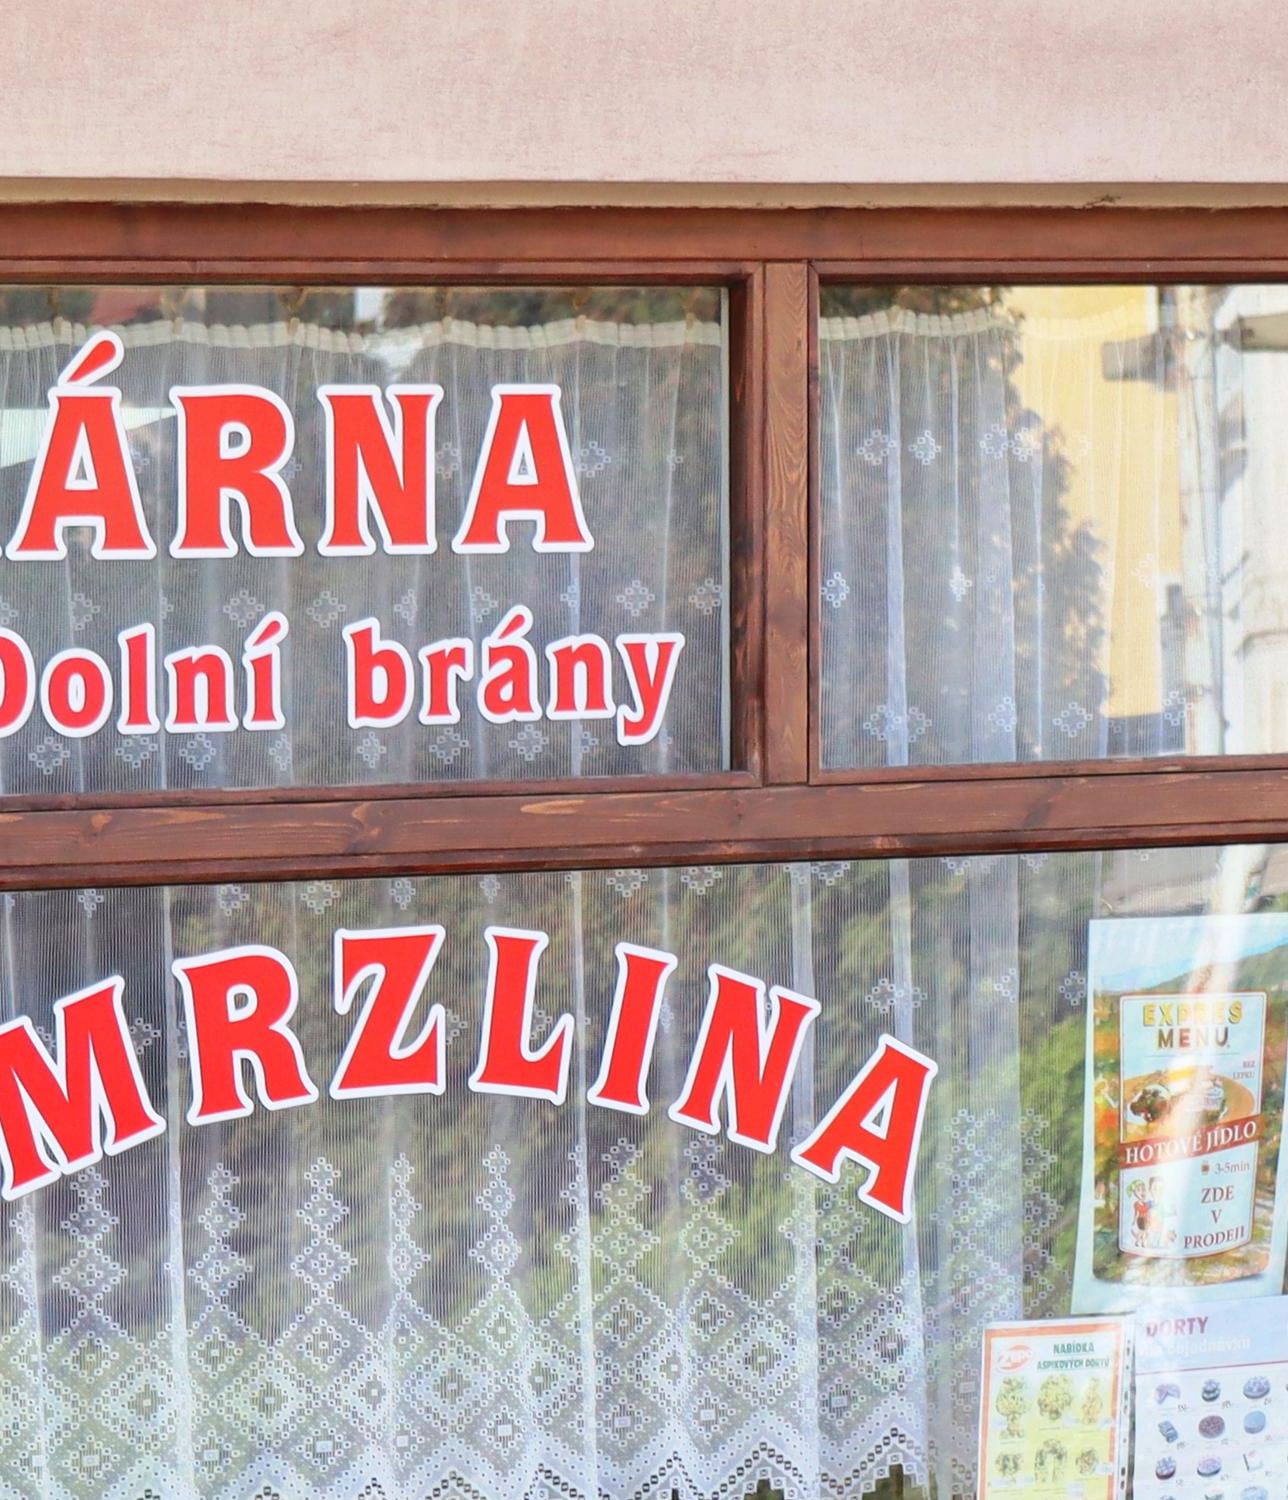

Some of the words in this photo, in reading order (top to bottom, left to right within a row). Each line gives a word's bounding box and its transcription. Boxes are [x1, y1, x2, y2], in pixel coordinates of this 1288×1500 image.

[342, 604, 685, 747] brány
[1142, 1001, 1243, 1027] EXPRES
[1157, 1027, 1229, 1049] MENU
[1125, 1130, 1203, 1165] HOTOVÉ
[1206, 1120, 1258, 1152] JÍDLO
[1200, 1185, 1234, 1204] ZDE
[1211, 1208, 1223, 1224] V
[1183, 1225, 1245, 1250] PRODEJI
